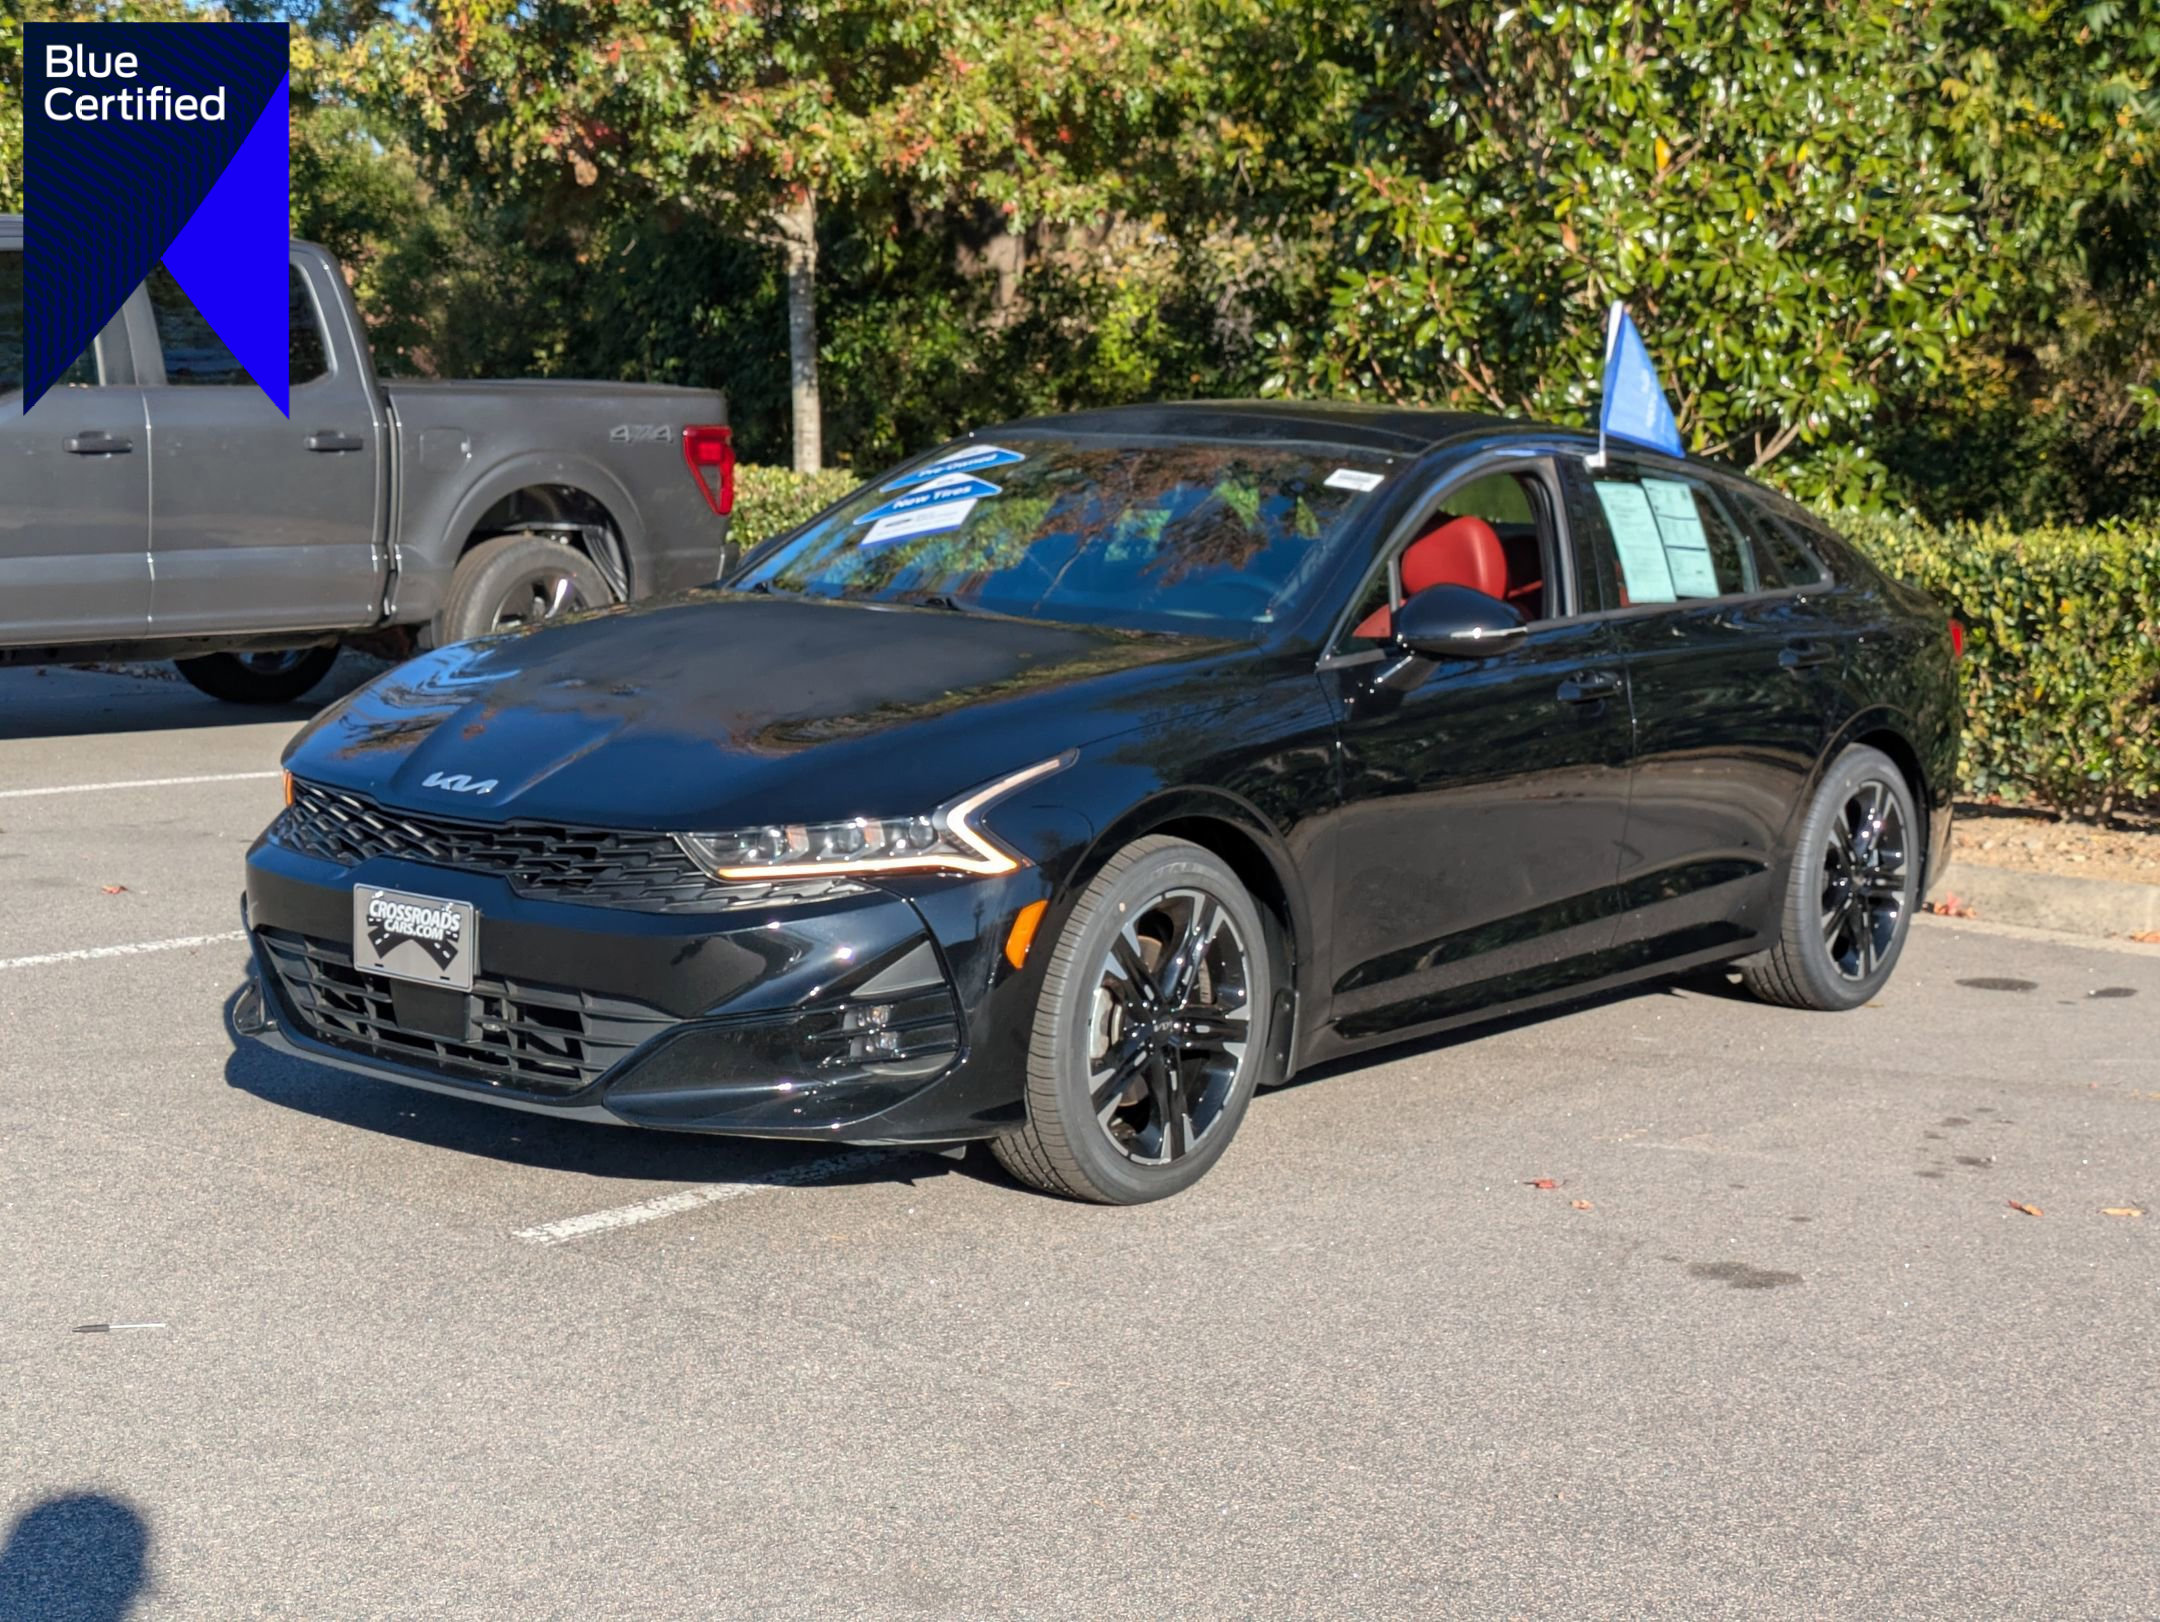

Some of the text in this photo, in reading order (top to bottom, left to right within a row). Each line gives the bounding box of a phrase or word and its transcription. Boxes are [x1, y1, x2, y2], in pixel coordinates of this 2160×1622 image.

[892, 485, 973, 510] New Tires
[368, 899, 461, 932] CROSSROADS
[383, 919, 445, 941] CARS.COM
